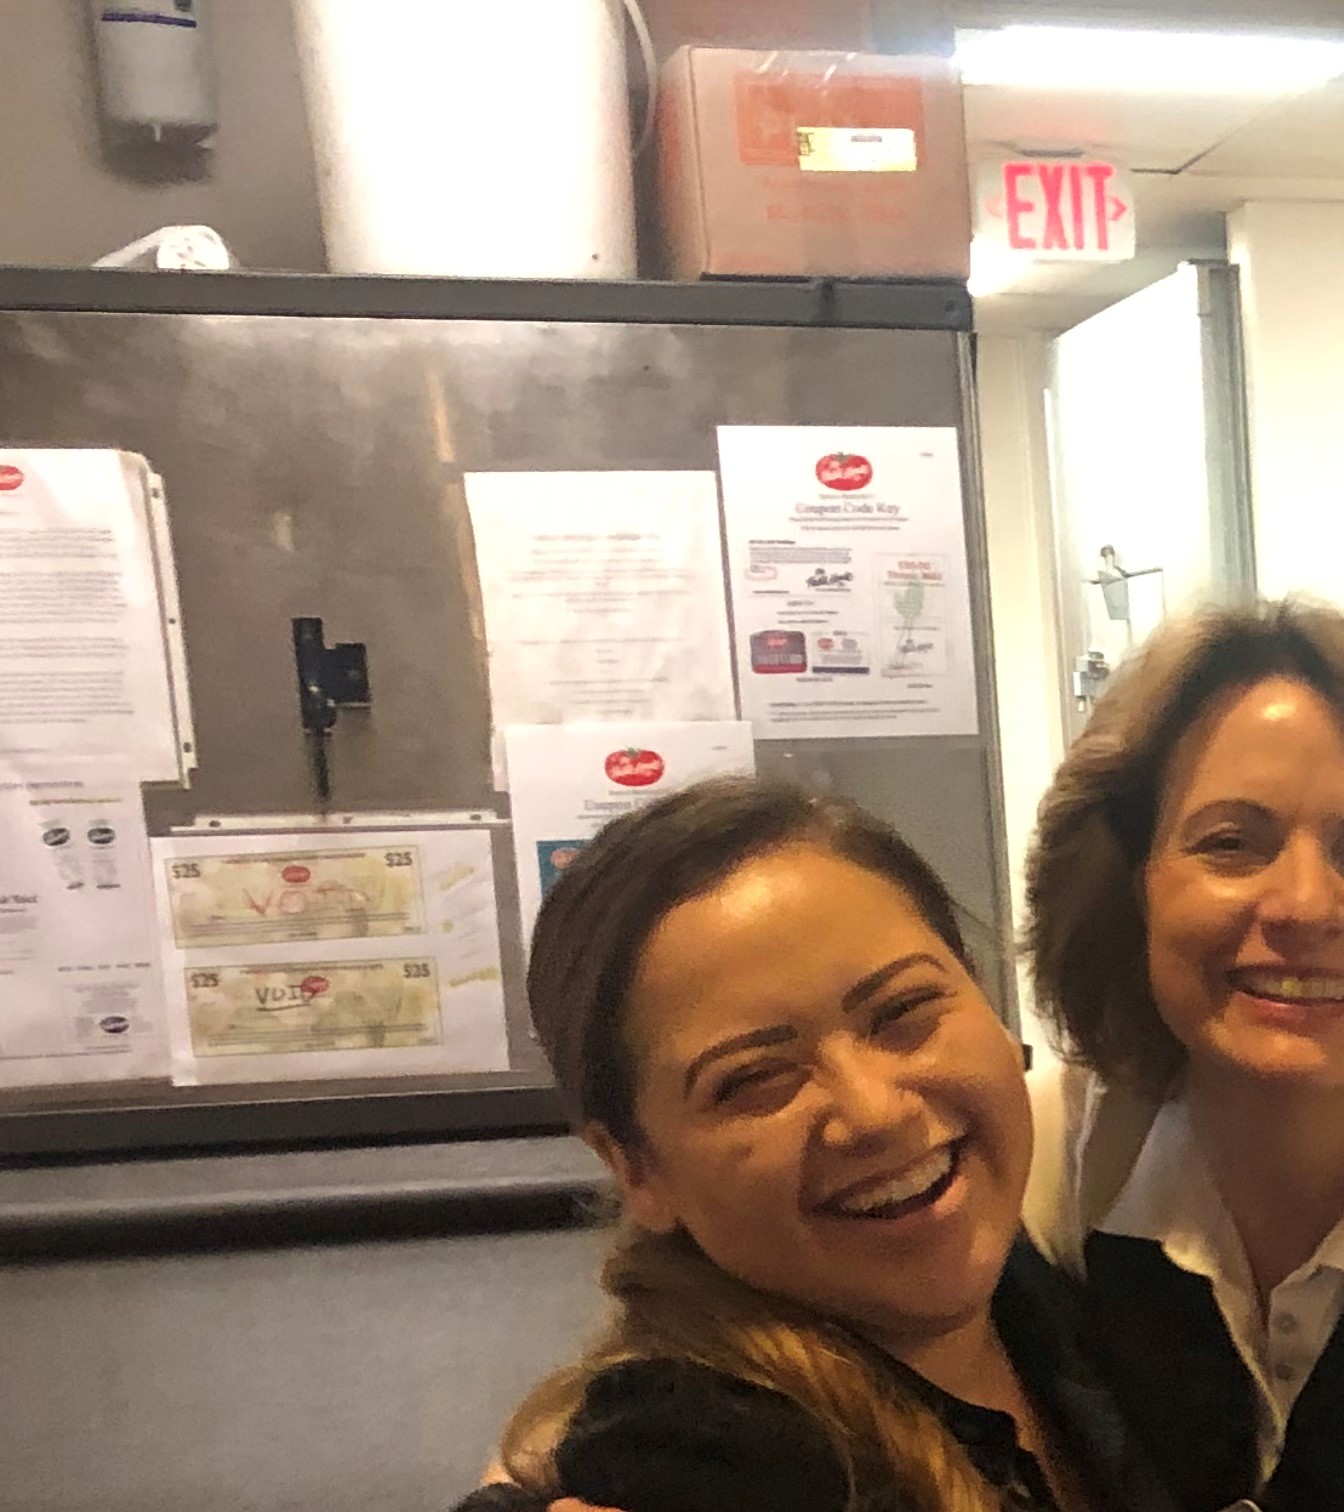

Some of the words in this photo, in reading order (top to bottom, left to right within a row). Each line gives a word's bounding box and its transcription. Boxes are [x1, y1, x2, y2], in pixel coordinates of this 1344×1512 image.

[1003, 162, 1115, 251] EXIT
[384, 851, 412, 867] $25
[171, 863, 201, 879] $25
